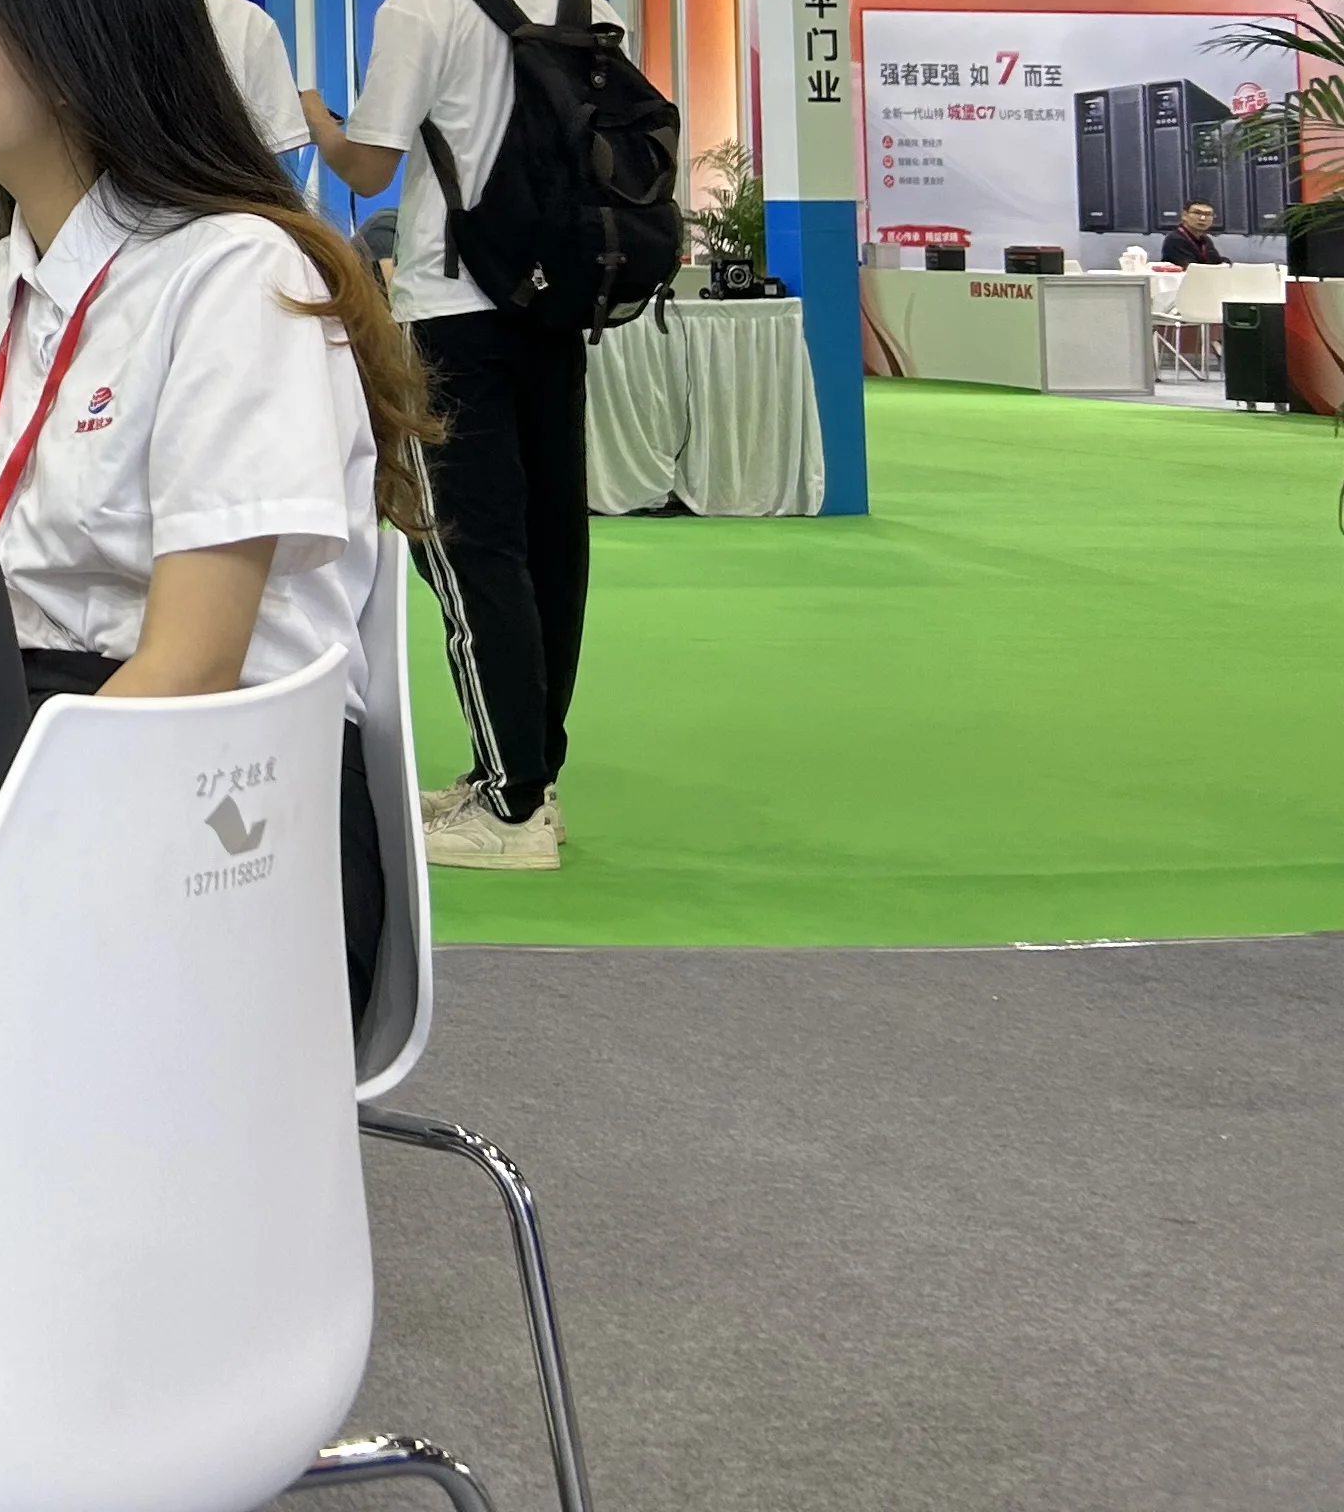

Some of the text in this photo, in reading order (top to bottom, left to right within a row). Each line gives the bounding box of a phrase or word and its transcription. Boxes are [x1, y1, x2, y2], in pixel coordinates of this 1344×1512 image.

[880, 62, 961, 87] 强者更强
[998, 108, 1022, 121] UPS
[983, 281, 1034, 300] SANTAK
